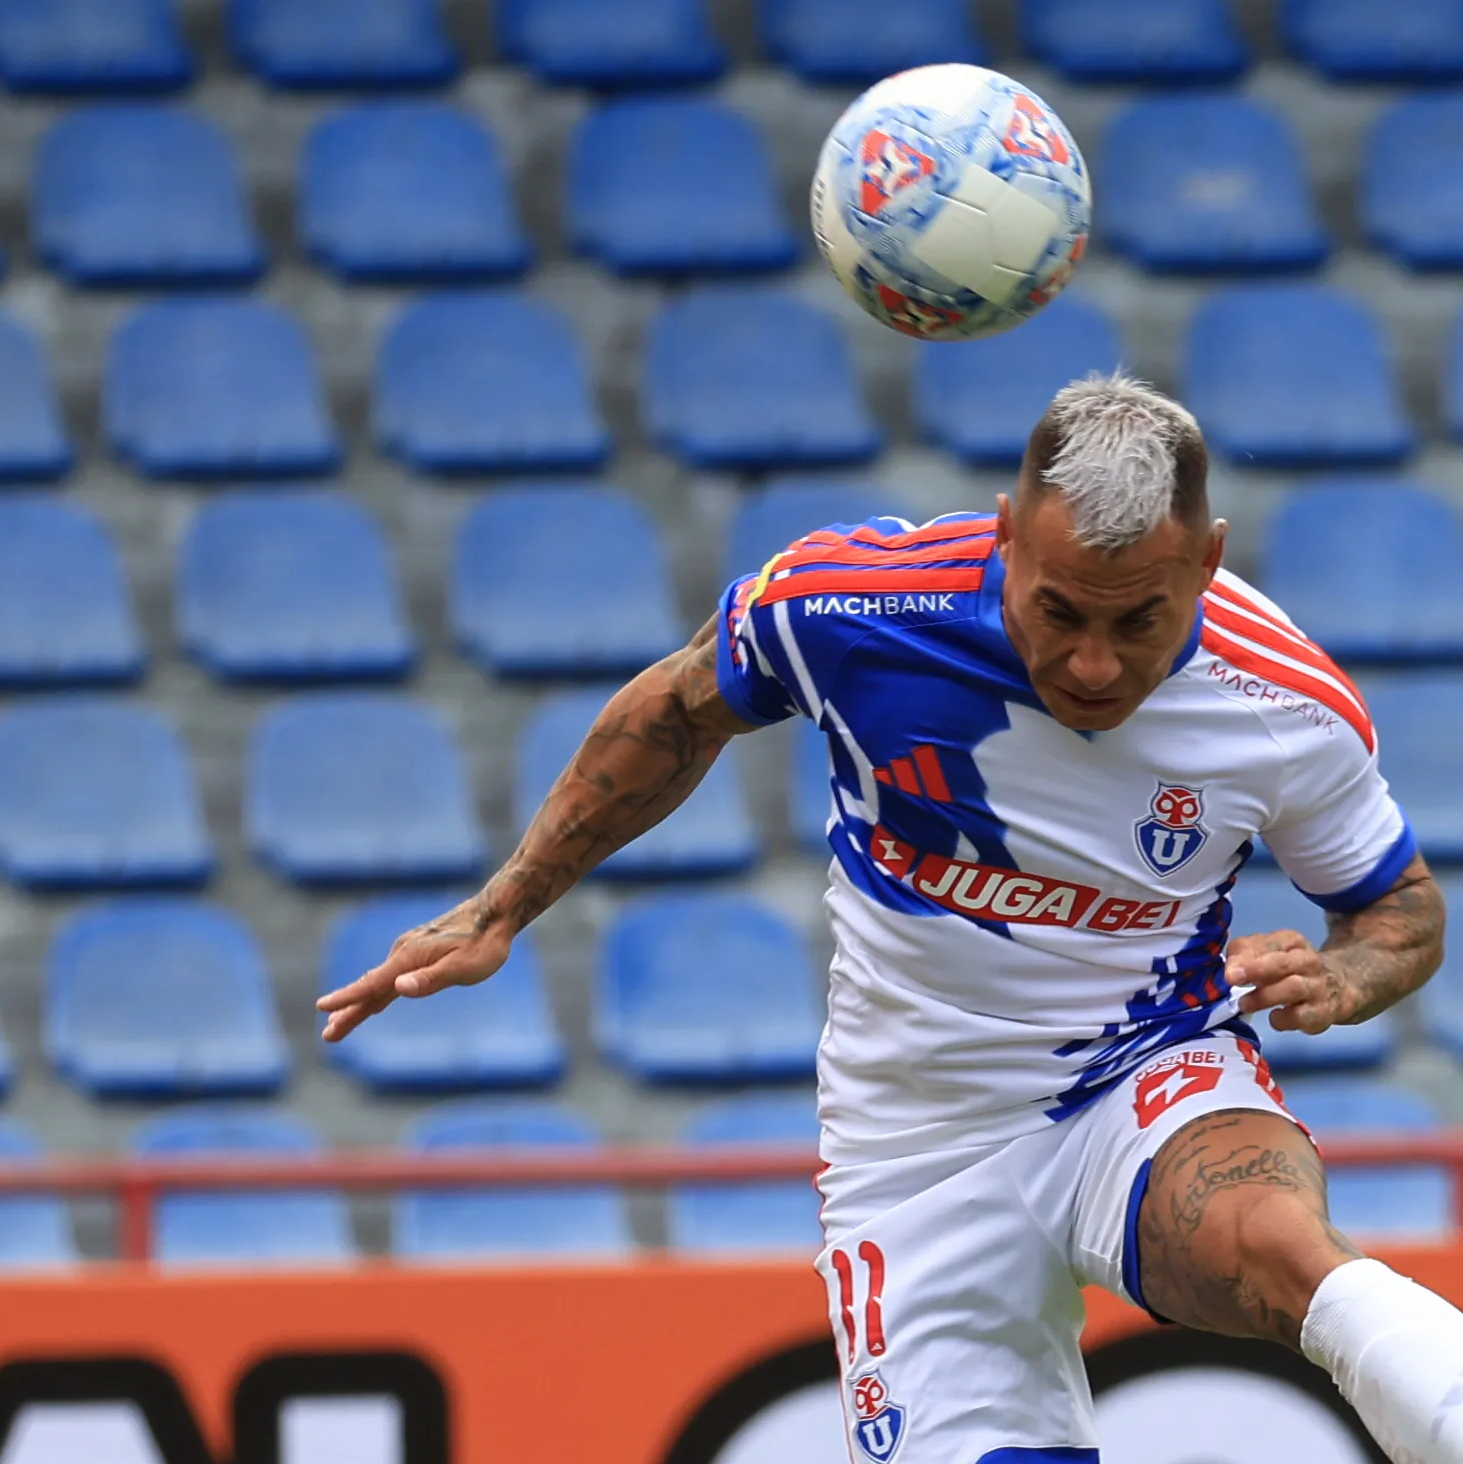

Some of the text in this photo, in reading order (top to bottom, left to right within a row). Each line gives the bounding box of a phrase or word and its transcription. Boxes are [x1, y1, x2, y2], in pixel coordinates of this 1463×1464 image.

[804, 593, 955, 617] MACHBANK
[1207, 661, 1340, 736] MACHBANK
[831, 1239, 886, 1366] 11
